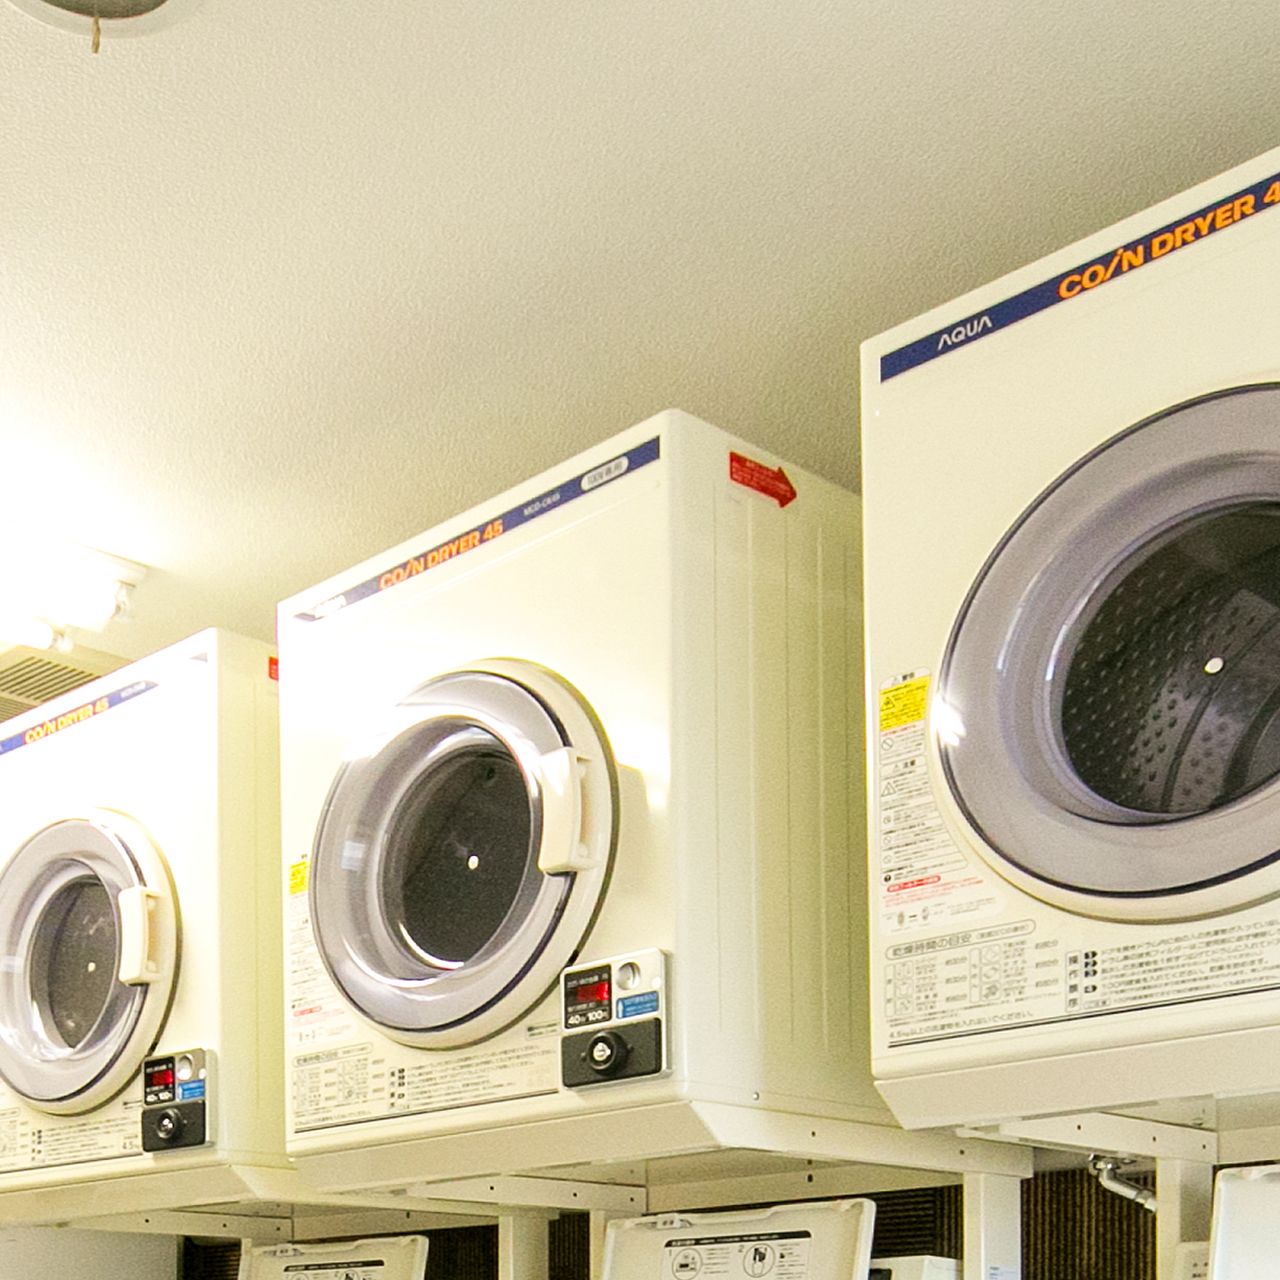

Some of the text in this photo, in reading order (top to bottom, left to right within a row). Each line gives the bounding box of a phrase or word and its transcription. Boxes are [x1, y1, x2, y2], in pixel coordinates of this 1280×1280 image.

[1150, 194, 1256, 259] DRYER
[937, 315, 992, 350] AQUA
[426, 531, 480, 569] DRYER
[482, 519, 503, 541] 45
